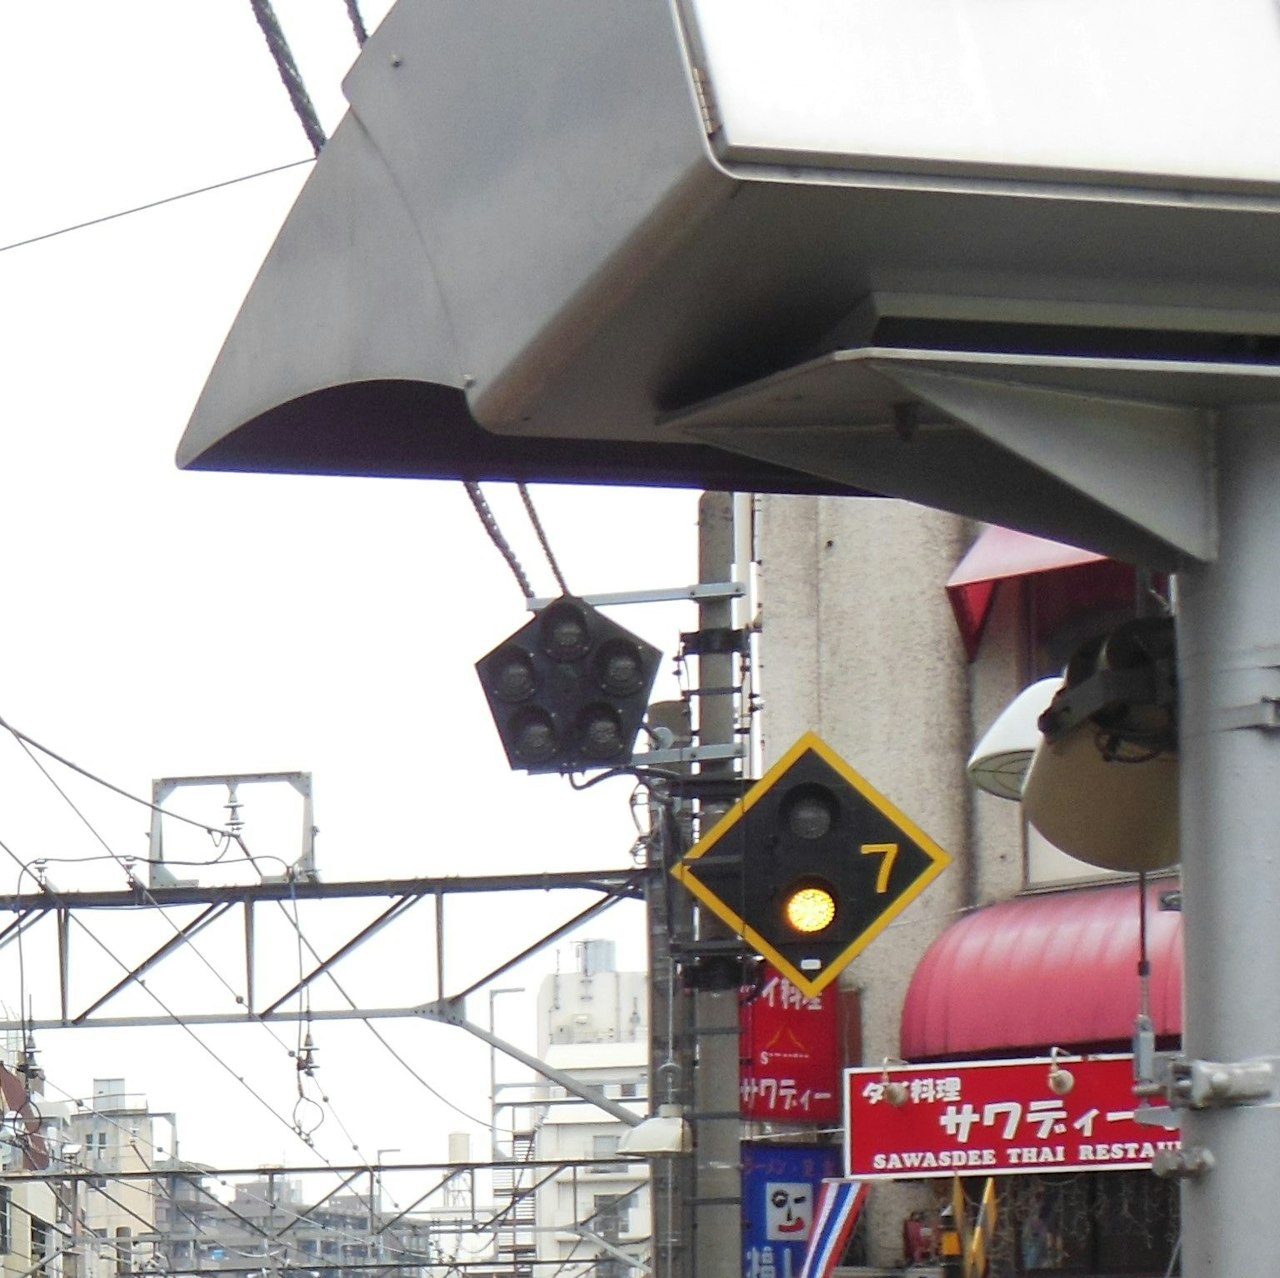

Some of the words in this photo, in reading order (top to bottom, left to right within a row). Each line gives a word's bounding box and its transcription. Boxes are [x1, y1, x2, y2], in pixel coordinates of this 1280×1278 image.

[861, 843, 898, 893] 7
[862, 1077, 962, 1104] タ料理
[940, 1100, 1136, 1143] サワディー
[873, 1149, 996, 1169] SAWASDEE
[1007, 1146, 1066, 1164] THAI
